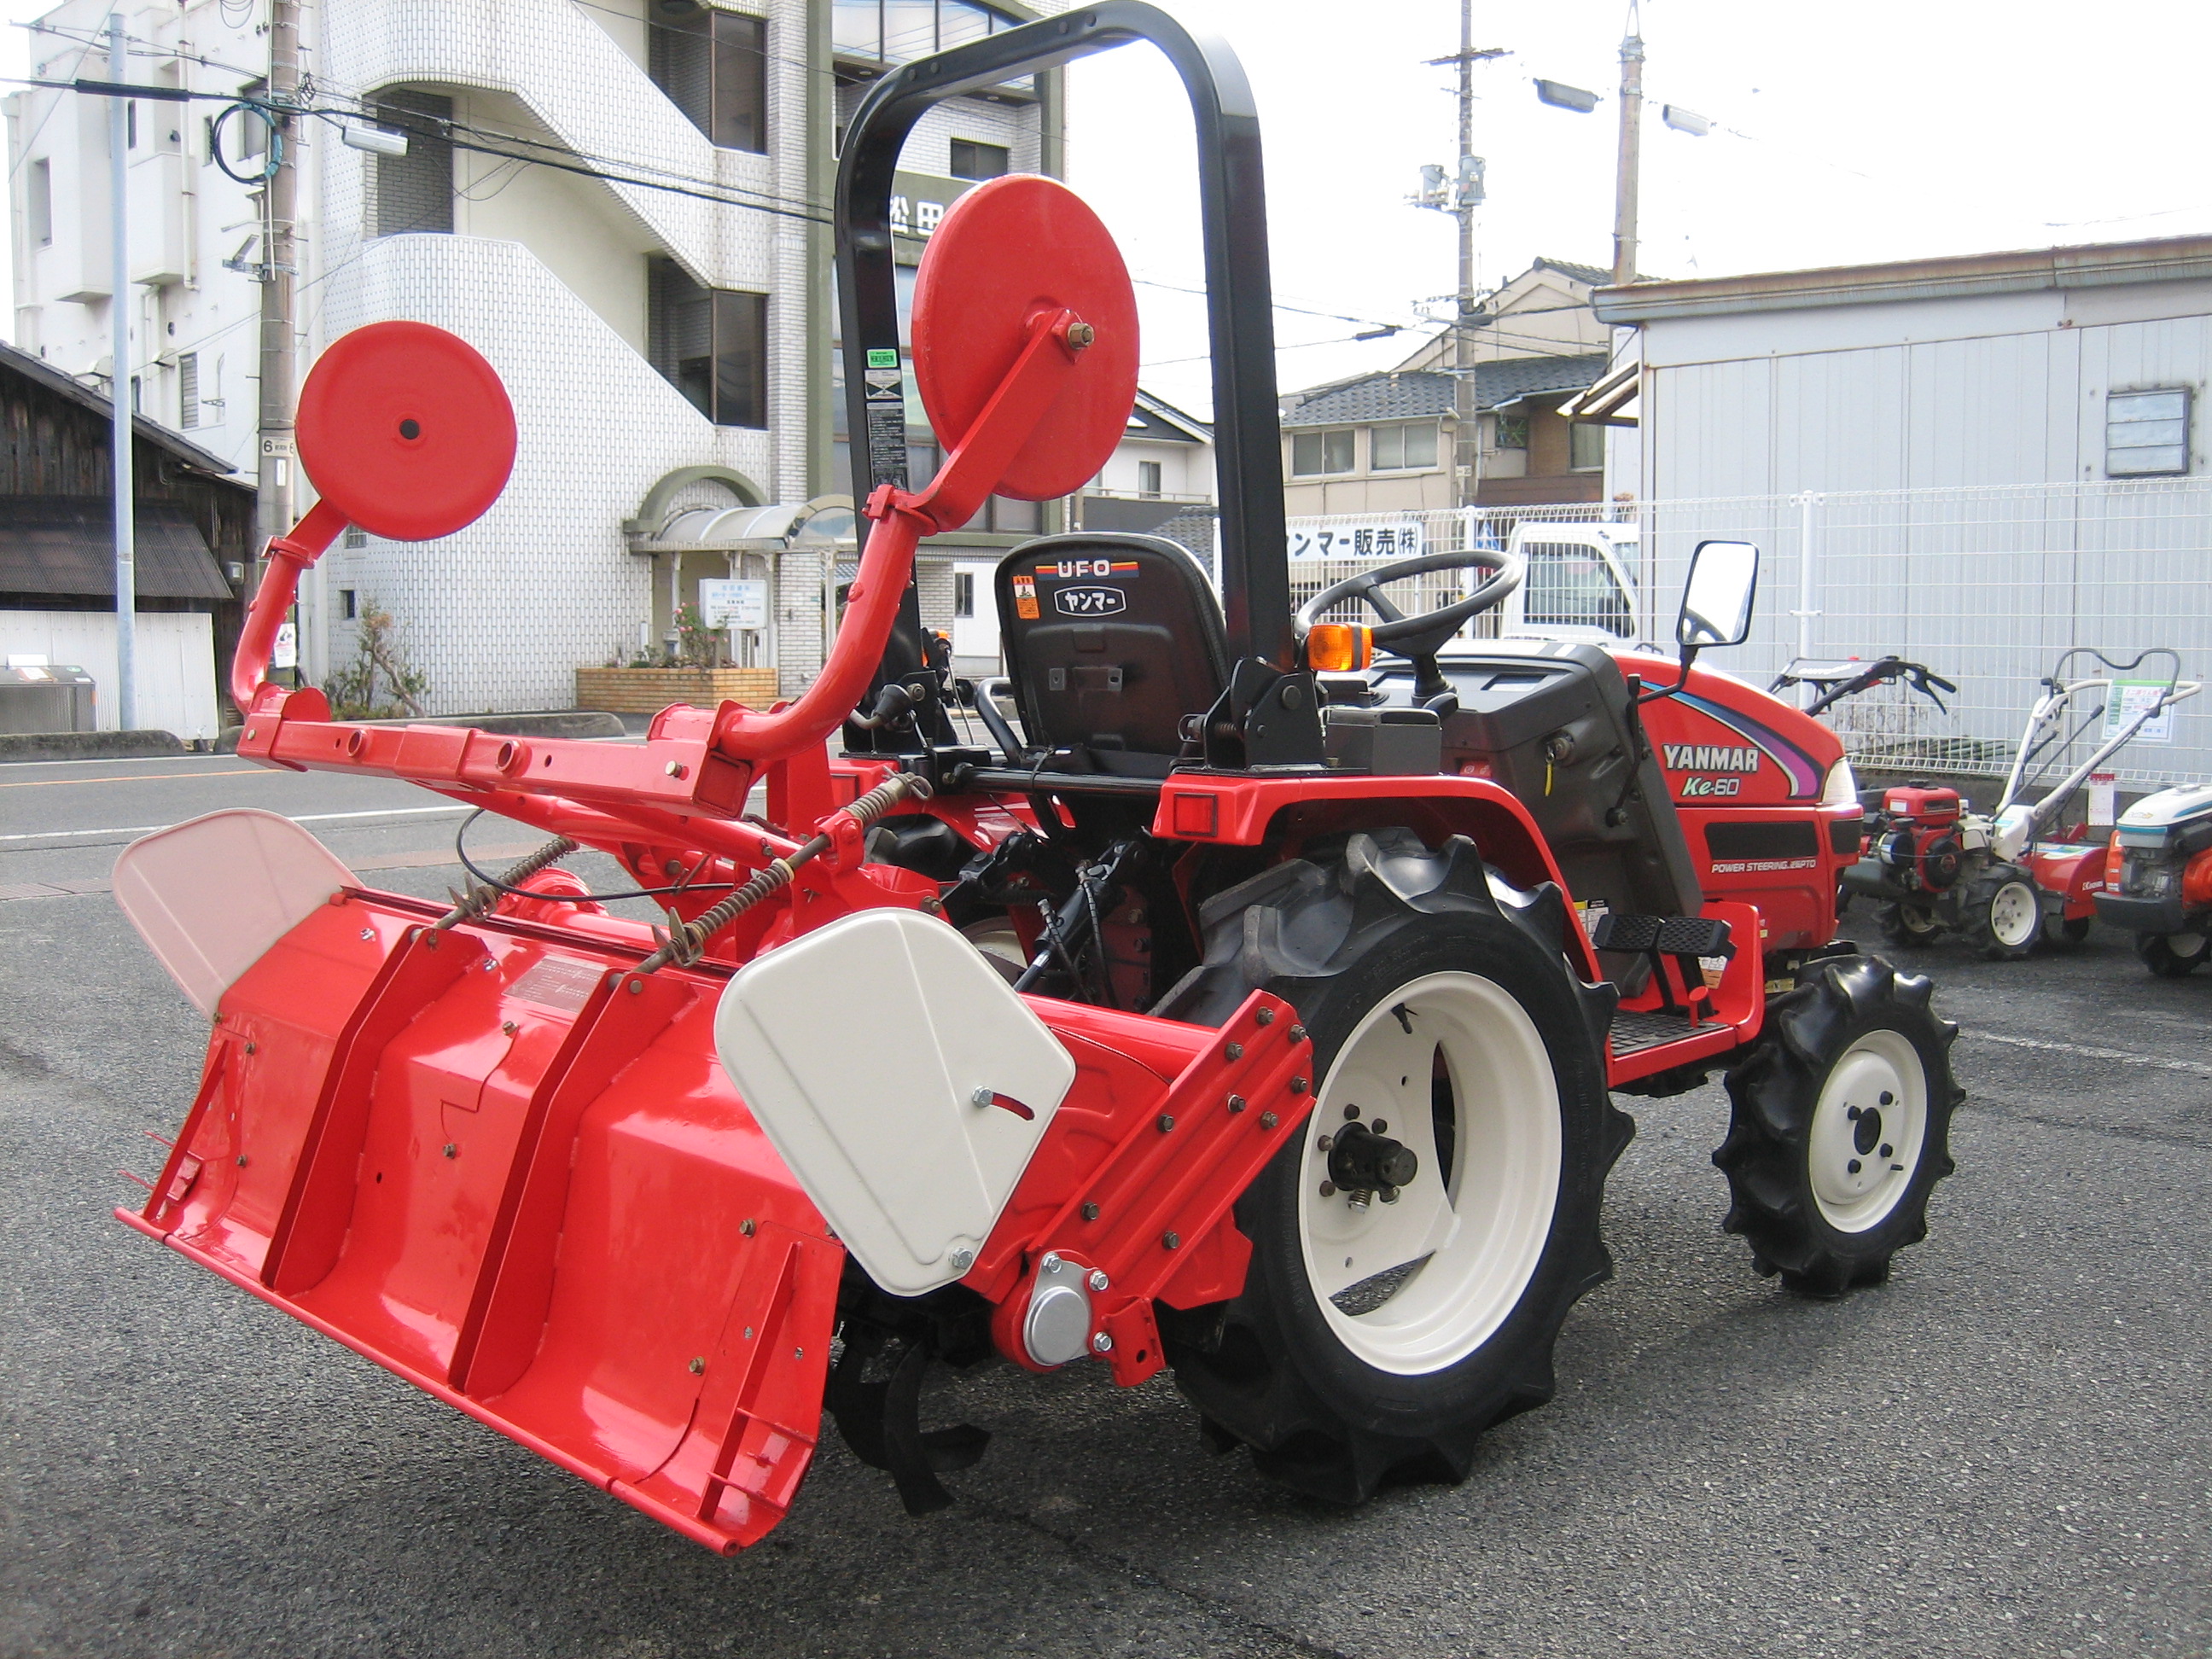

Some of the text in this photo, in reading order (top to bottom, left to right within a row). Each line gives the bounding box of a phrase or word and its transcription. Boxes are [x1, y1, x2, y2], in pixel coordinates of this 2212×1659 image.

[264, 439, 273, 453] 6
[1287, 527, 1418, 556] ンマー販売(株)
[1057, 559, 1110, 578] UFO
[1064, 591, 1116, 612] ヤンマー
[1662, 744, 1759, 772] YANMAR
[1681, 777, 1740, 796] Ke-60
[1712, 863, 1745, 873] POWER
